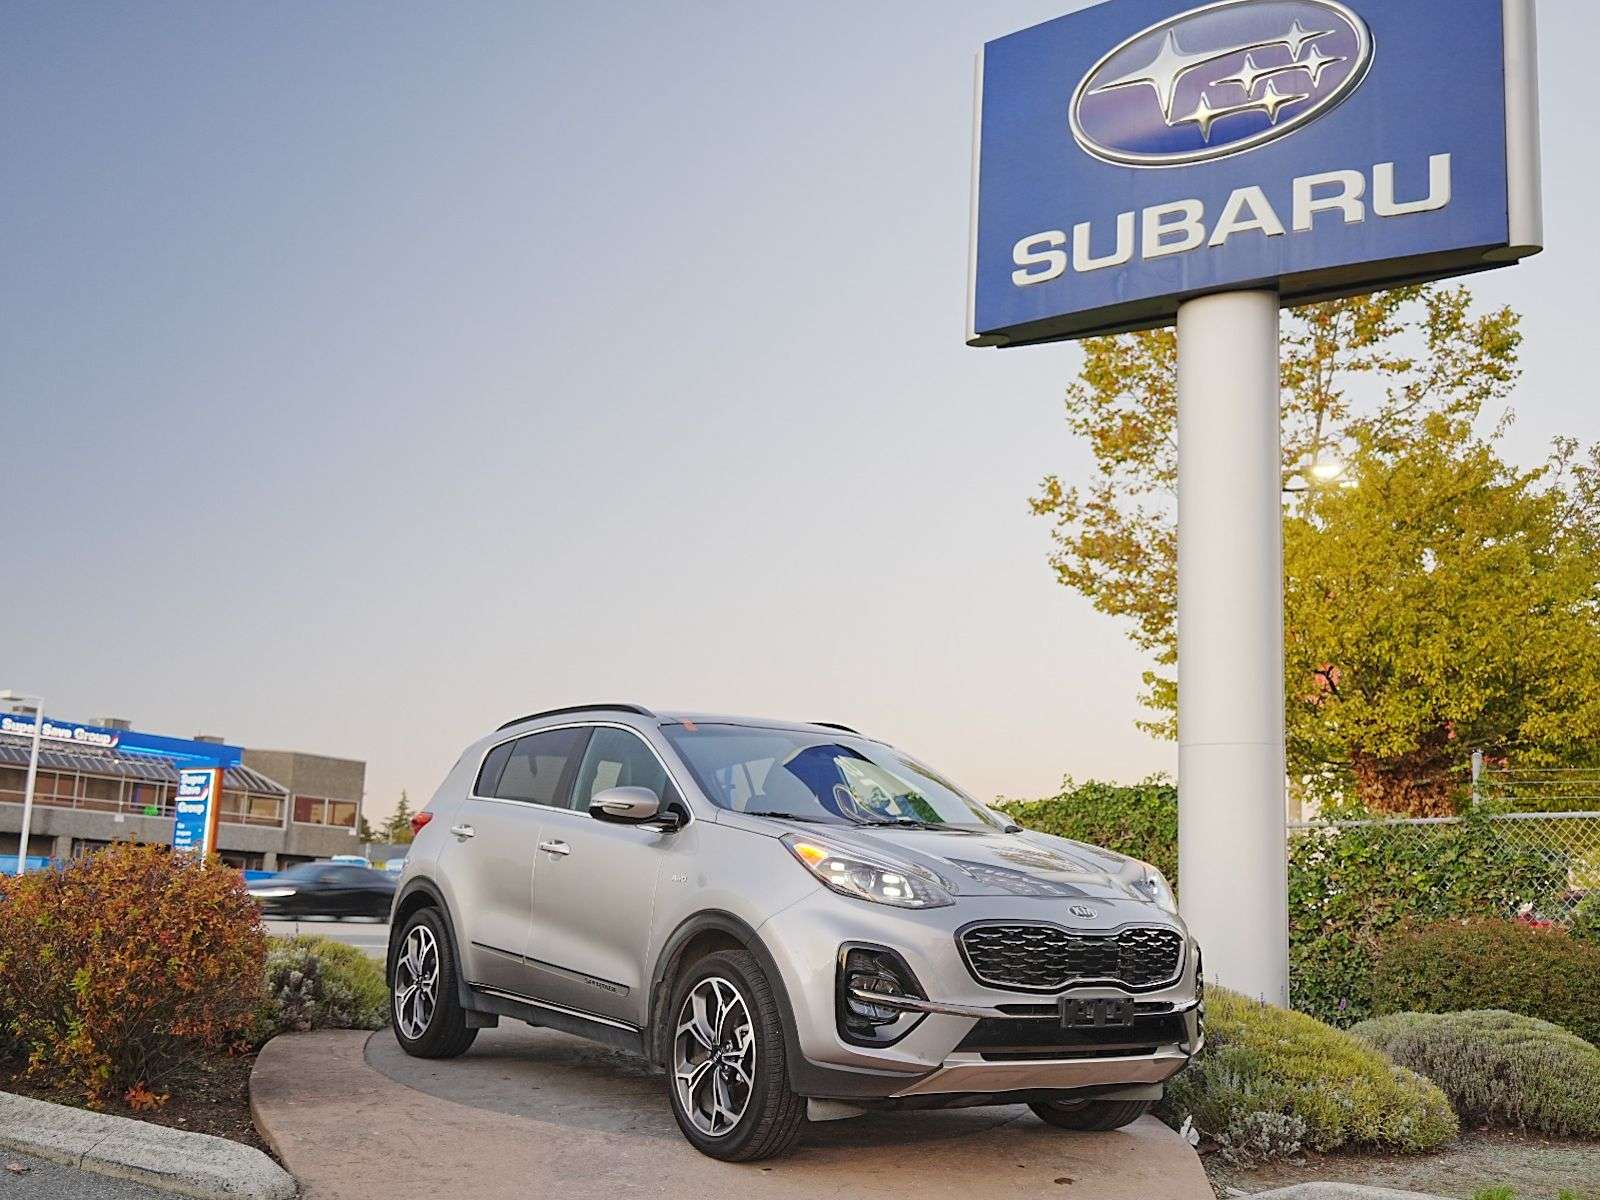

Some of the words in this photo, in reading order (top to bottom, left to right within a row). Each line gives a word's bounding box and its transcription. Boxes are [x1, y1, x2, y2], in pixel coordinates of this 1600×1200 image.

[1010, 152, 1452, 288] SUBARU
[2, 718, 39, 734] Supe
[42, 723, 72, 738] Save
[74, 728, 111, 743] Group
[177, 802, 205, 815] Group
